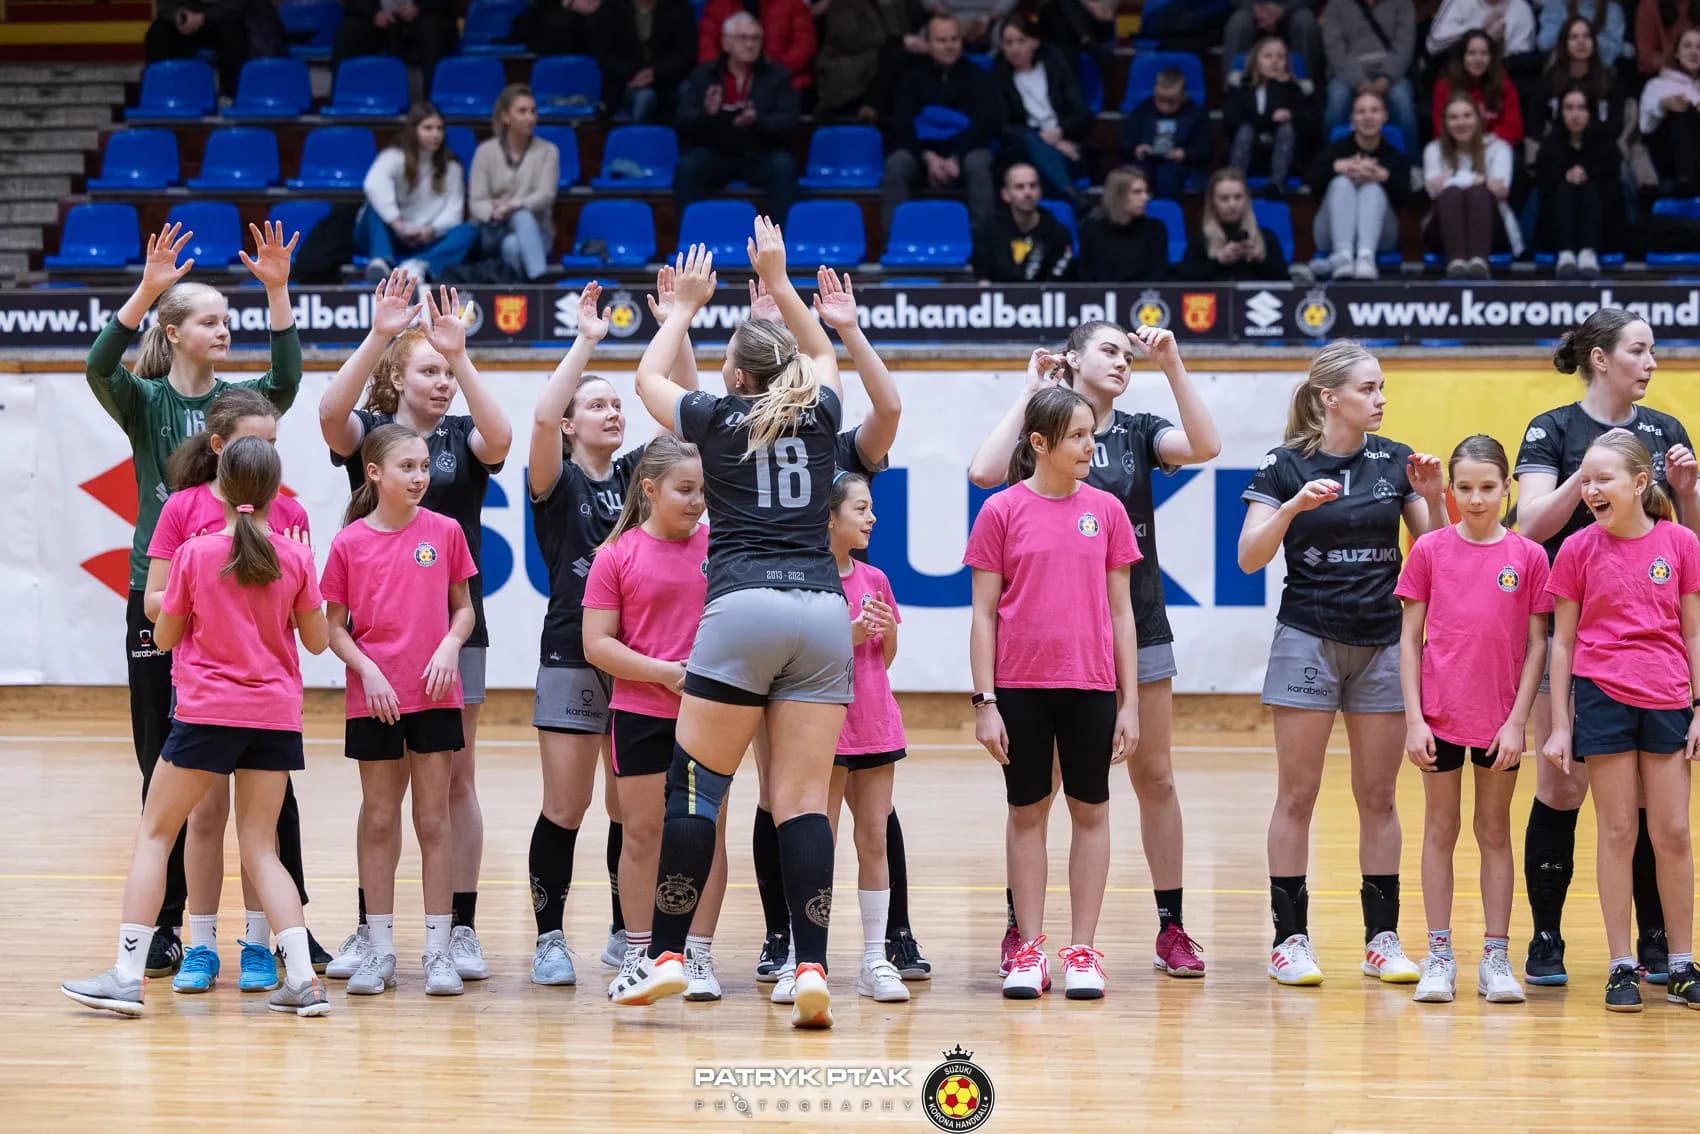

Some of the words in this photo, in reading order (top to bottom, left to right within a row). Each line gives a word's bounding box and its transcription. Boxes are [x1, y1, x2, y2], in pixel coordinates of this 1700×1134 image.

[754, 436, 813, 509] 18
[1327, 548, 1397, 563] SUZUKI
[766, 570, 783, 580] 2013
